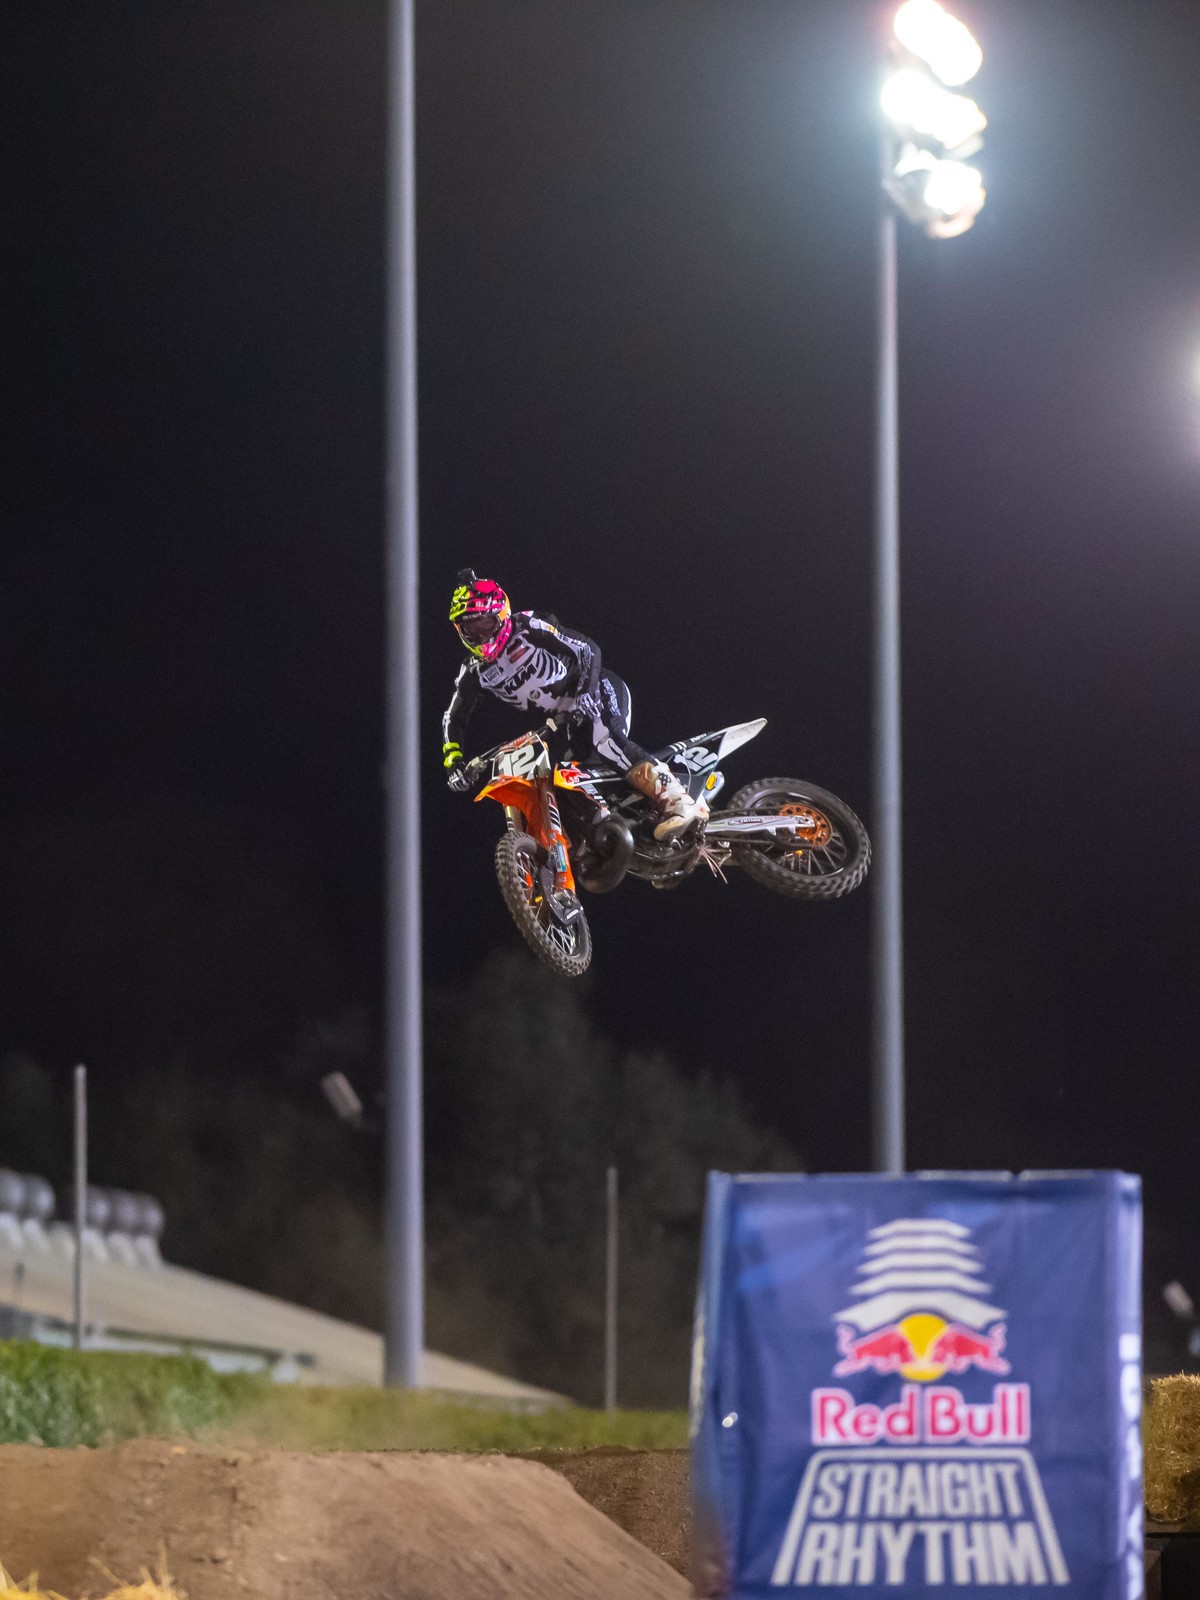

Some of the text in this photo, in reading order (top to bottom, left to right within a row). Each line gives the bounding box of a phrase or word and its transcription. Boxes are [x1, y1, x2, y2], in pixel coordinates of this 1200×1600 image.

[504, 663, 538, 695] KTM
[498, 744, 535, 780] 12
[673, 746, 719, 772] 12
[816, 1387, 1029, 1442] Red Bull
[811, 1462, 1025, 1518] STRAIGHT
[795, 1521, 1048, 1586] RHYTHM
